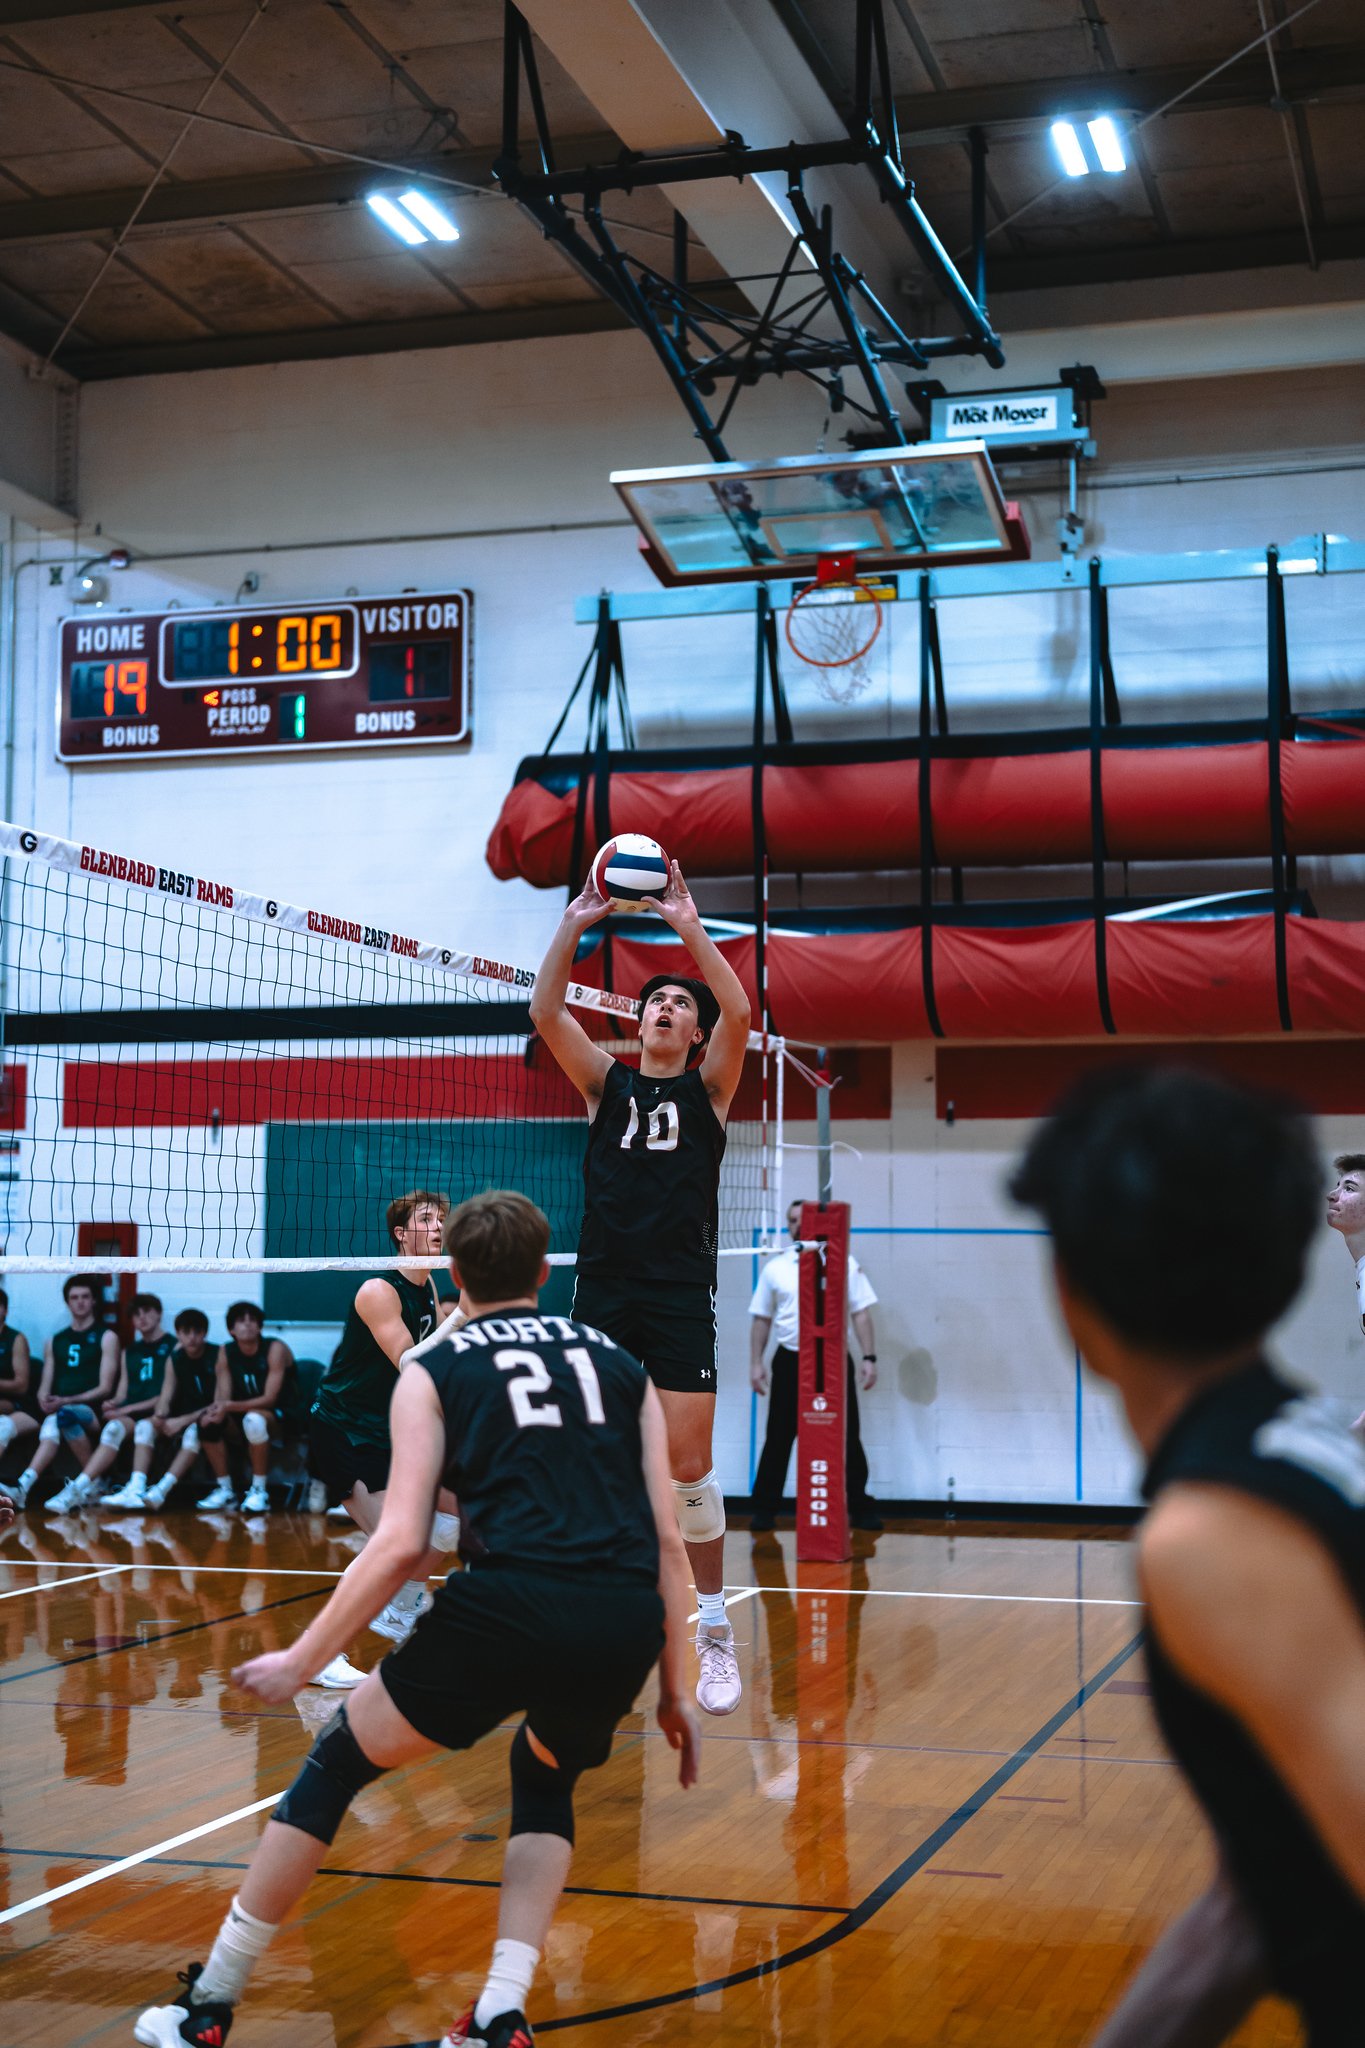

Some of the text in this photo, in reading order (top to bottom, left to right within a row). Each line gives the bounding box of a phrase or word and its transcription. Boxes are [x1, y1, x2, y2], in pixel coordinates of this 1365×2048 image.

[992, 404, 1048, 421] Mover
[362, 603, 459, 634] VISITOR
[77, 624, 145, 653] HOME
[228, 615, 342, 675] 1:00
[103, 661, 148, 717] 19
[222, 687, 257, 704] POSS
[207, 704, 271, 728] PERIOD
[294, 694, 305, 739] 1
[355, 709, 417, 733] BONUS
[102, 724, 160, 747] BONUS
[20, 831, 38, 853] G
[80, 846, 234, 908] GLENBARD EAST RAMS
[266, 900, 278, 918] G
[307, 910, 419, 958] GLENBARD EAST RAMS
[441, 949, 451, 965] G
[472, 956, 536, 989] GLENBARD EAST
[620, 1096, 679, 1151] 10
[68, 1344, 80, 1367] 5
[493, 1347, 606, 1428] 21
